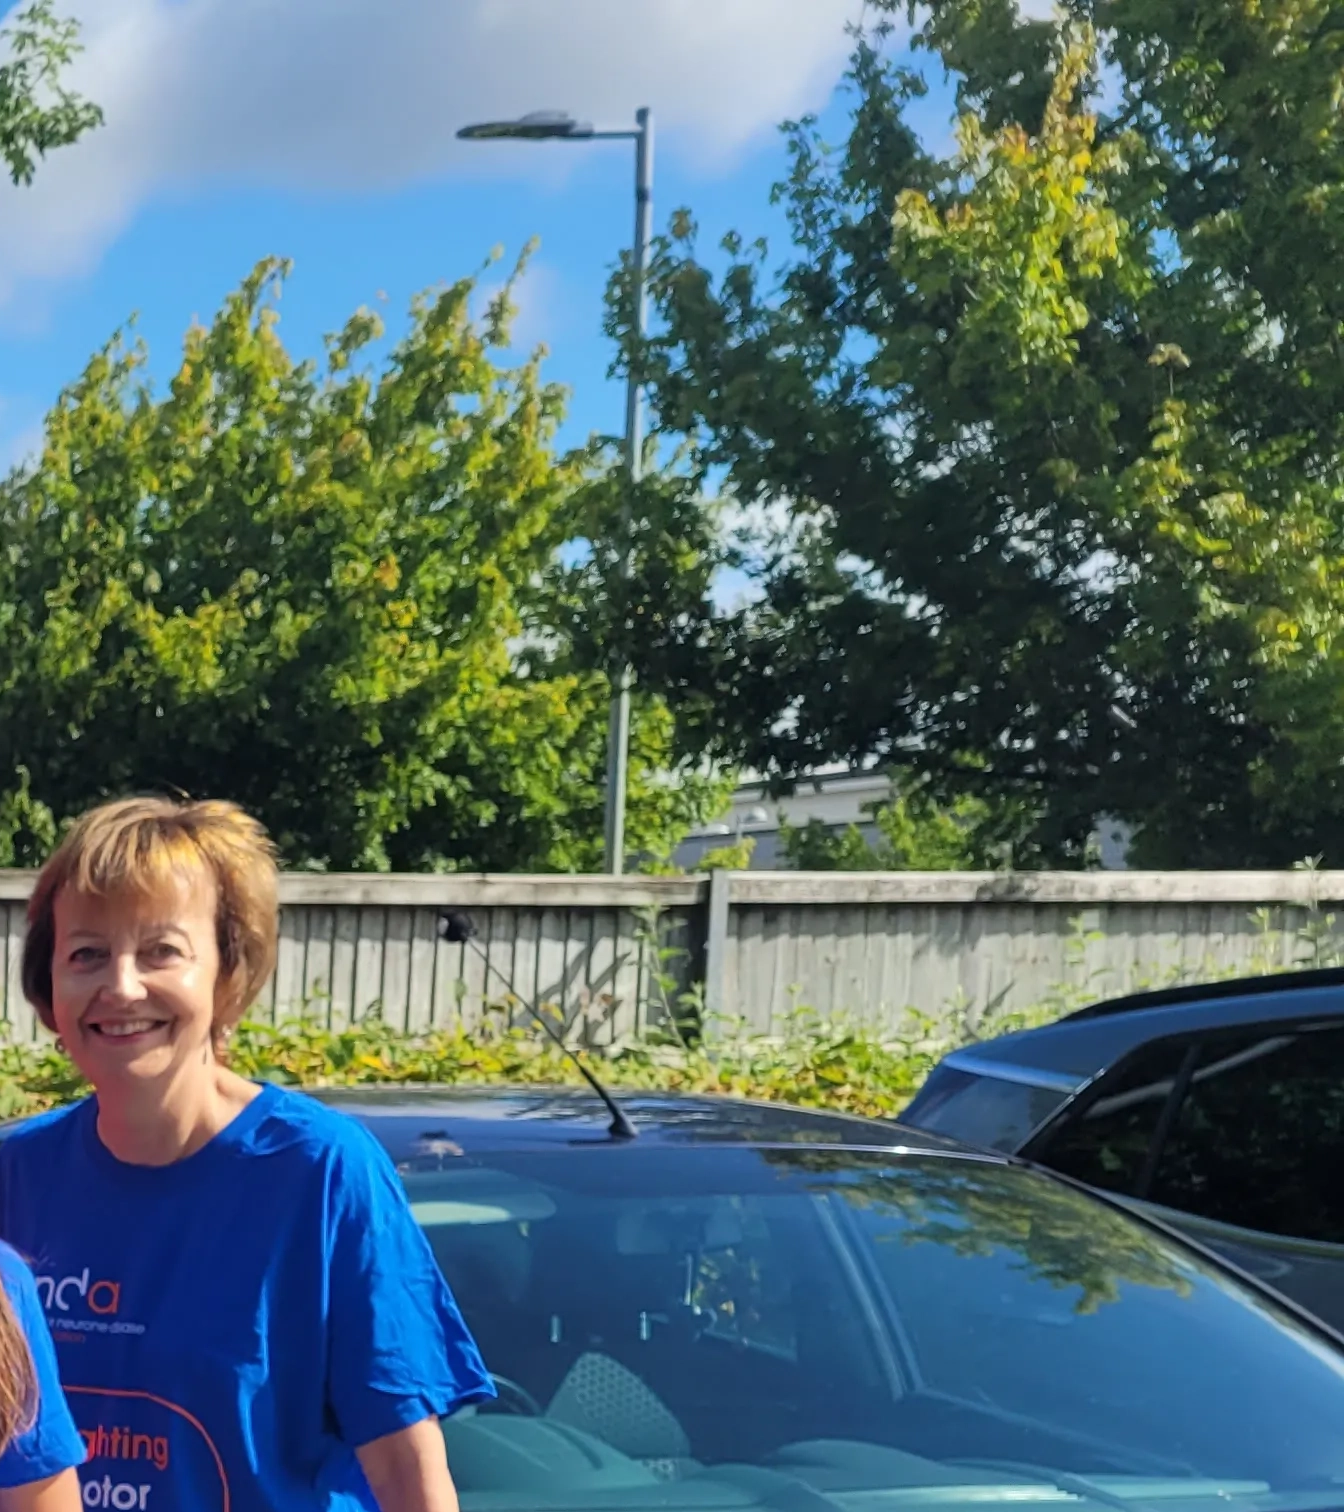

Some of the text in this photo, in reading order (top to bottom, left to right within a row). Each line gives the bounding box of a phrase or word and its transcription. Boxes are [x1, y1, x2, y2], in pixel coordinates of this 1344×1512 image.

[35, 1267, 121, 1314] nda
[79, 1423, 168, 1471] ghting
[83, 1474, 151, 1511] otor
